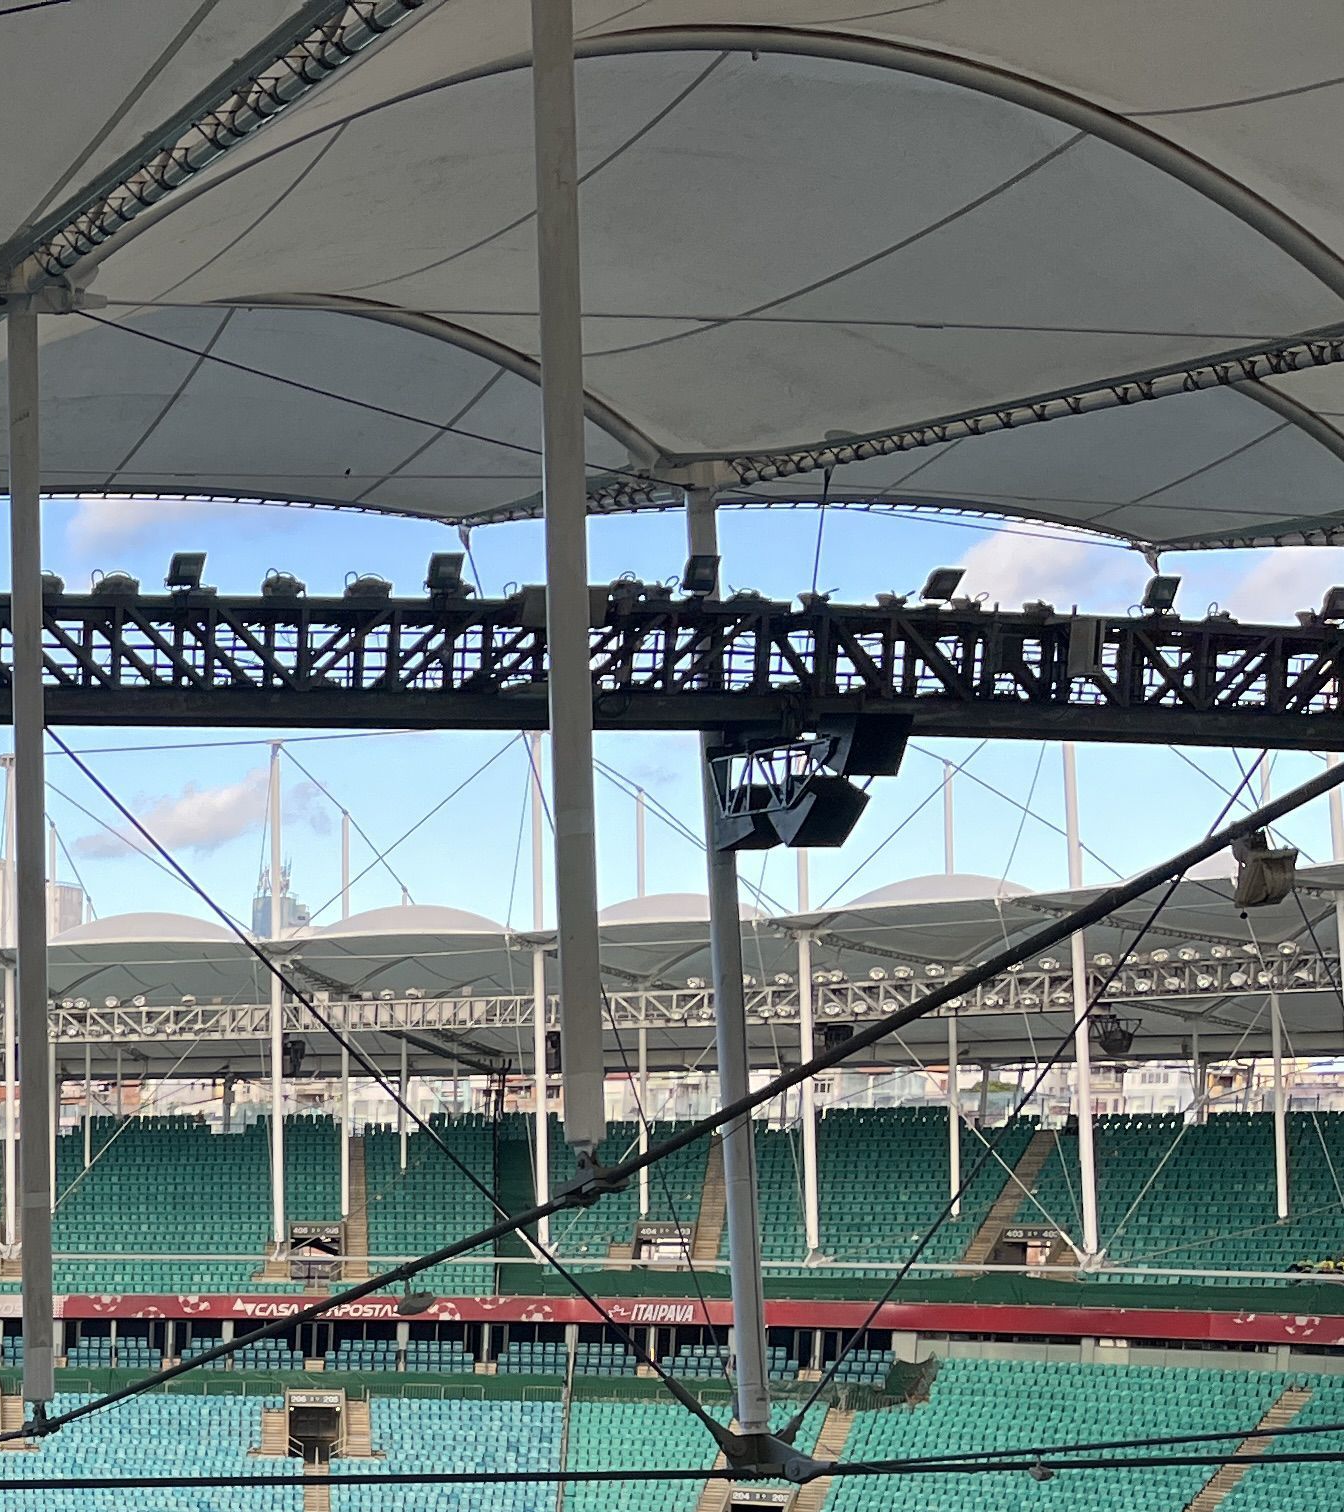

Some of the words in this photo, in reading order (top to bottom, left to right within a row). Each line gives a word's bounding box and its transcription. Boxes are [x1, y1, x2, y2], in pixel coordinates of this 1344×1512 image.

[255, 1302, 299, 1317] CASA
[630, 1303, 694, 1323] ITAIPAVA
[732, 1491, 750, 1500] 204
